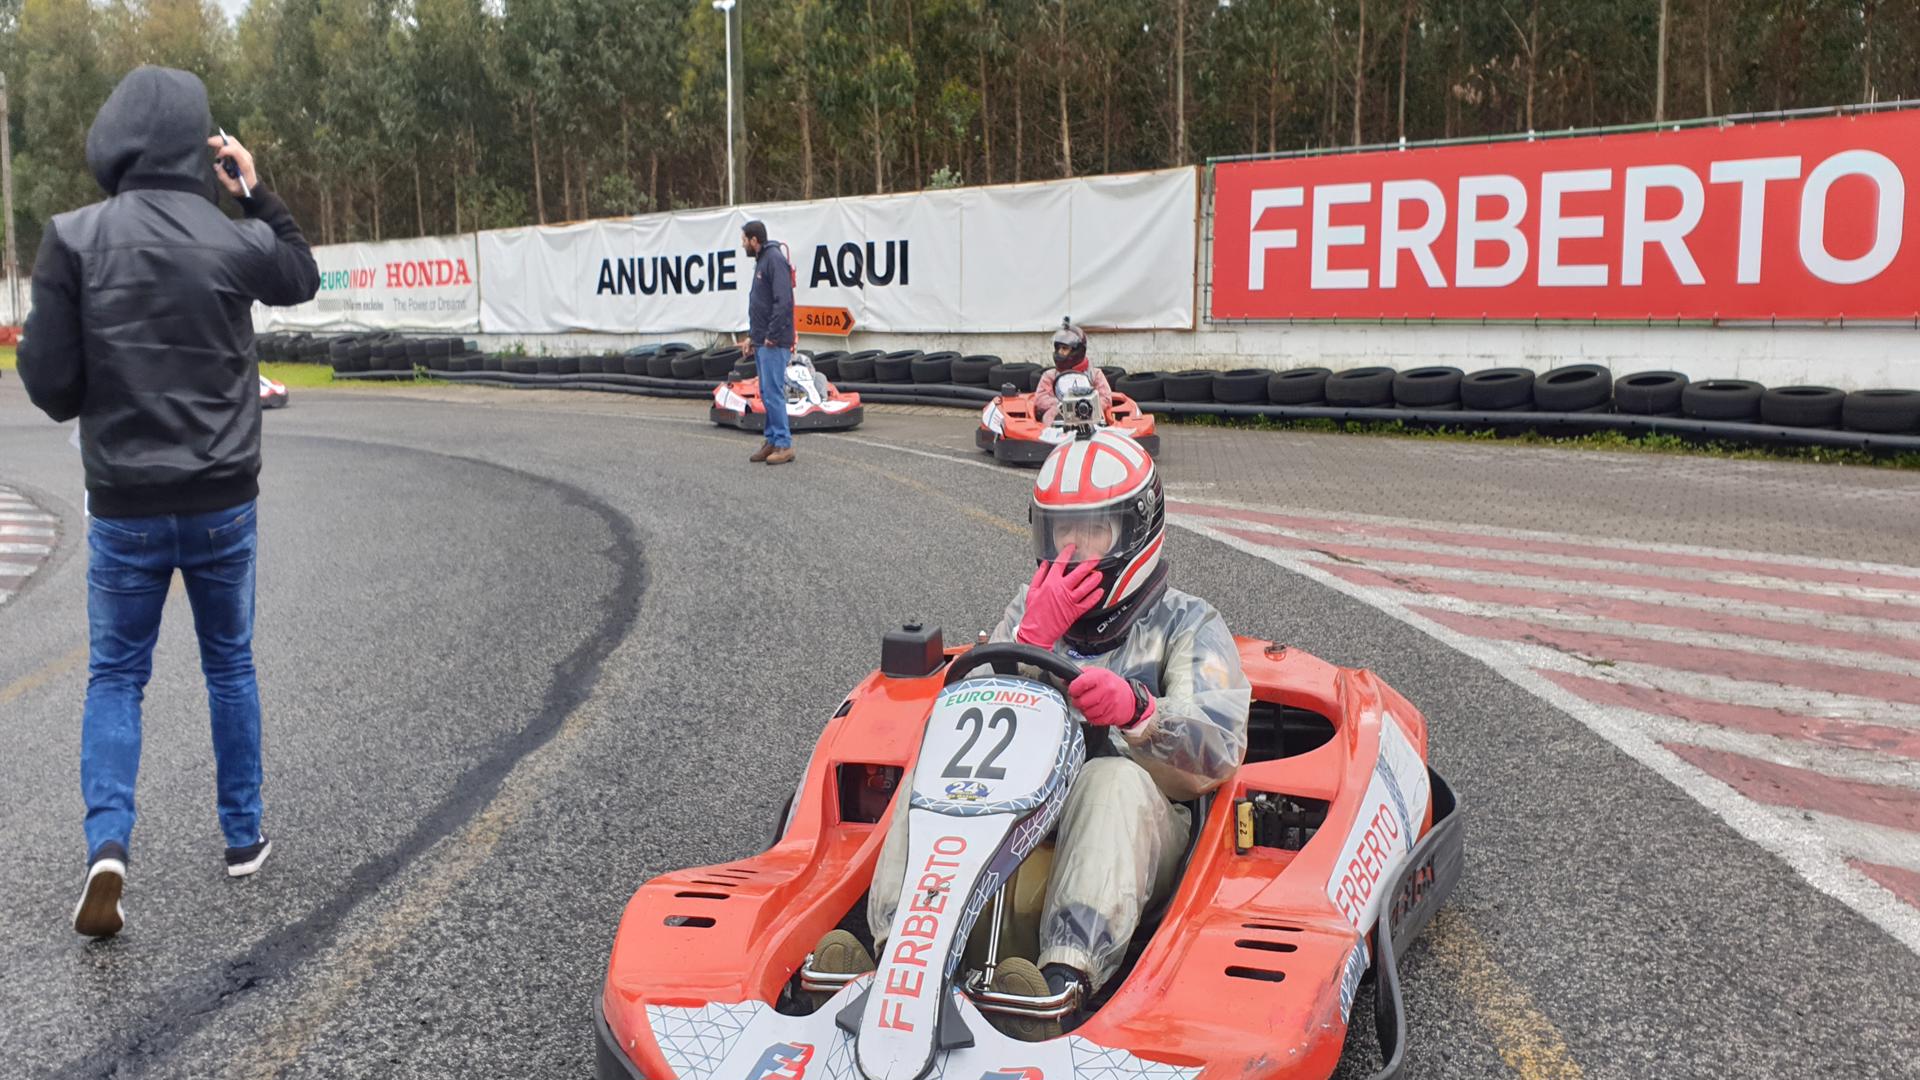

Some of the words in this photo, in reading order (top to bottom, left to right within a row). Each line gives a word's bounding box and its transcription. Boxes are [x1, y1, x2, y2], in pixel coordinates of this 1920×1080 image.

[1247, 148, 1906, 291] FERBERTO
[320, 268, 376, 290] EUROINDY
[386, 259, 471, 288] HONDA
[596, 249, 737, 296] ANUNCIE
[809, 239, 909, 290] AQUI
[806, 312, 841, 327] SAÍDA
[945, 691, 1041, 707] EUROINDY
[940, 707, 1017, 780] 22
[879, 835, 967, 1032] FERBERTO
